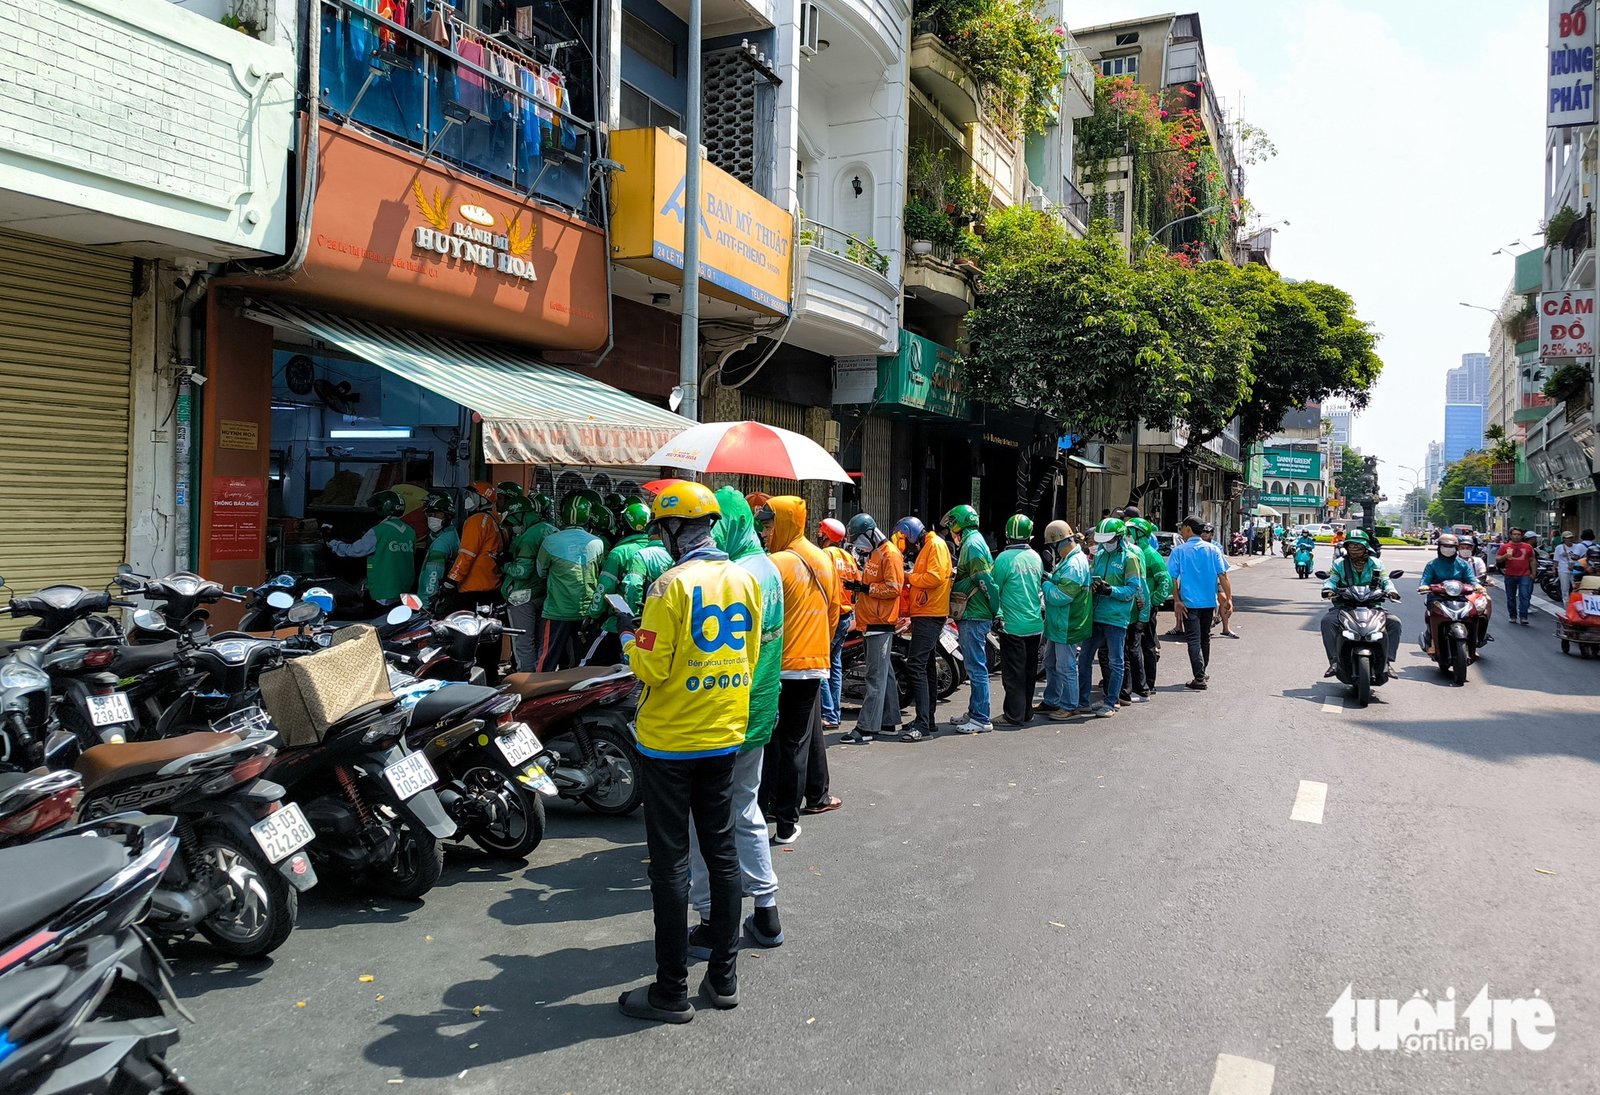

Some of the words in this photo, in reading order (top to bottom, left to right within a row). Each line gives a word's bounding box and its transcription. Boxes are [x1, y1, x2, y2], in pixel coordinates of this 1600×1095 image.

[1550, 43, 1594, 76] HÙNG
[1550, 79, 1593, 113] PHÁT
[454, 221, 493, 246] BÁNH
[707, 192, 733, 225] BẠN
[736, 209, 753, 237] MỸ
[755, 221, 788, 258] THUẬT
[497, 252, 538, 282] HOA
[1543, 292, 1593, 317] CẦM
[1550, 316, 1585, 340] ĐỒ
[1542, 343, 1568, 356] 2.5%
[1576, 342, 1593, 355] 3%
[507, 447, 518, 456] 26
[1110, 561, 1124, 570] Grab
[425, 571, 438, 594] Grab
[1160, 577, 1170, 598] Grab
[691, 585, 753, 653] be
[687, 659, 703, 667] Bên
[94, 707, 130, 724] 238.48
[507, 738, 539, 763] 304.78
[391, 757, 423, 781] 59-HA
[397, 769, 434, 796] 105.40
[267, 824, 310, 859] 242.88
